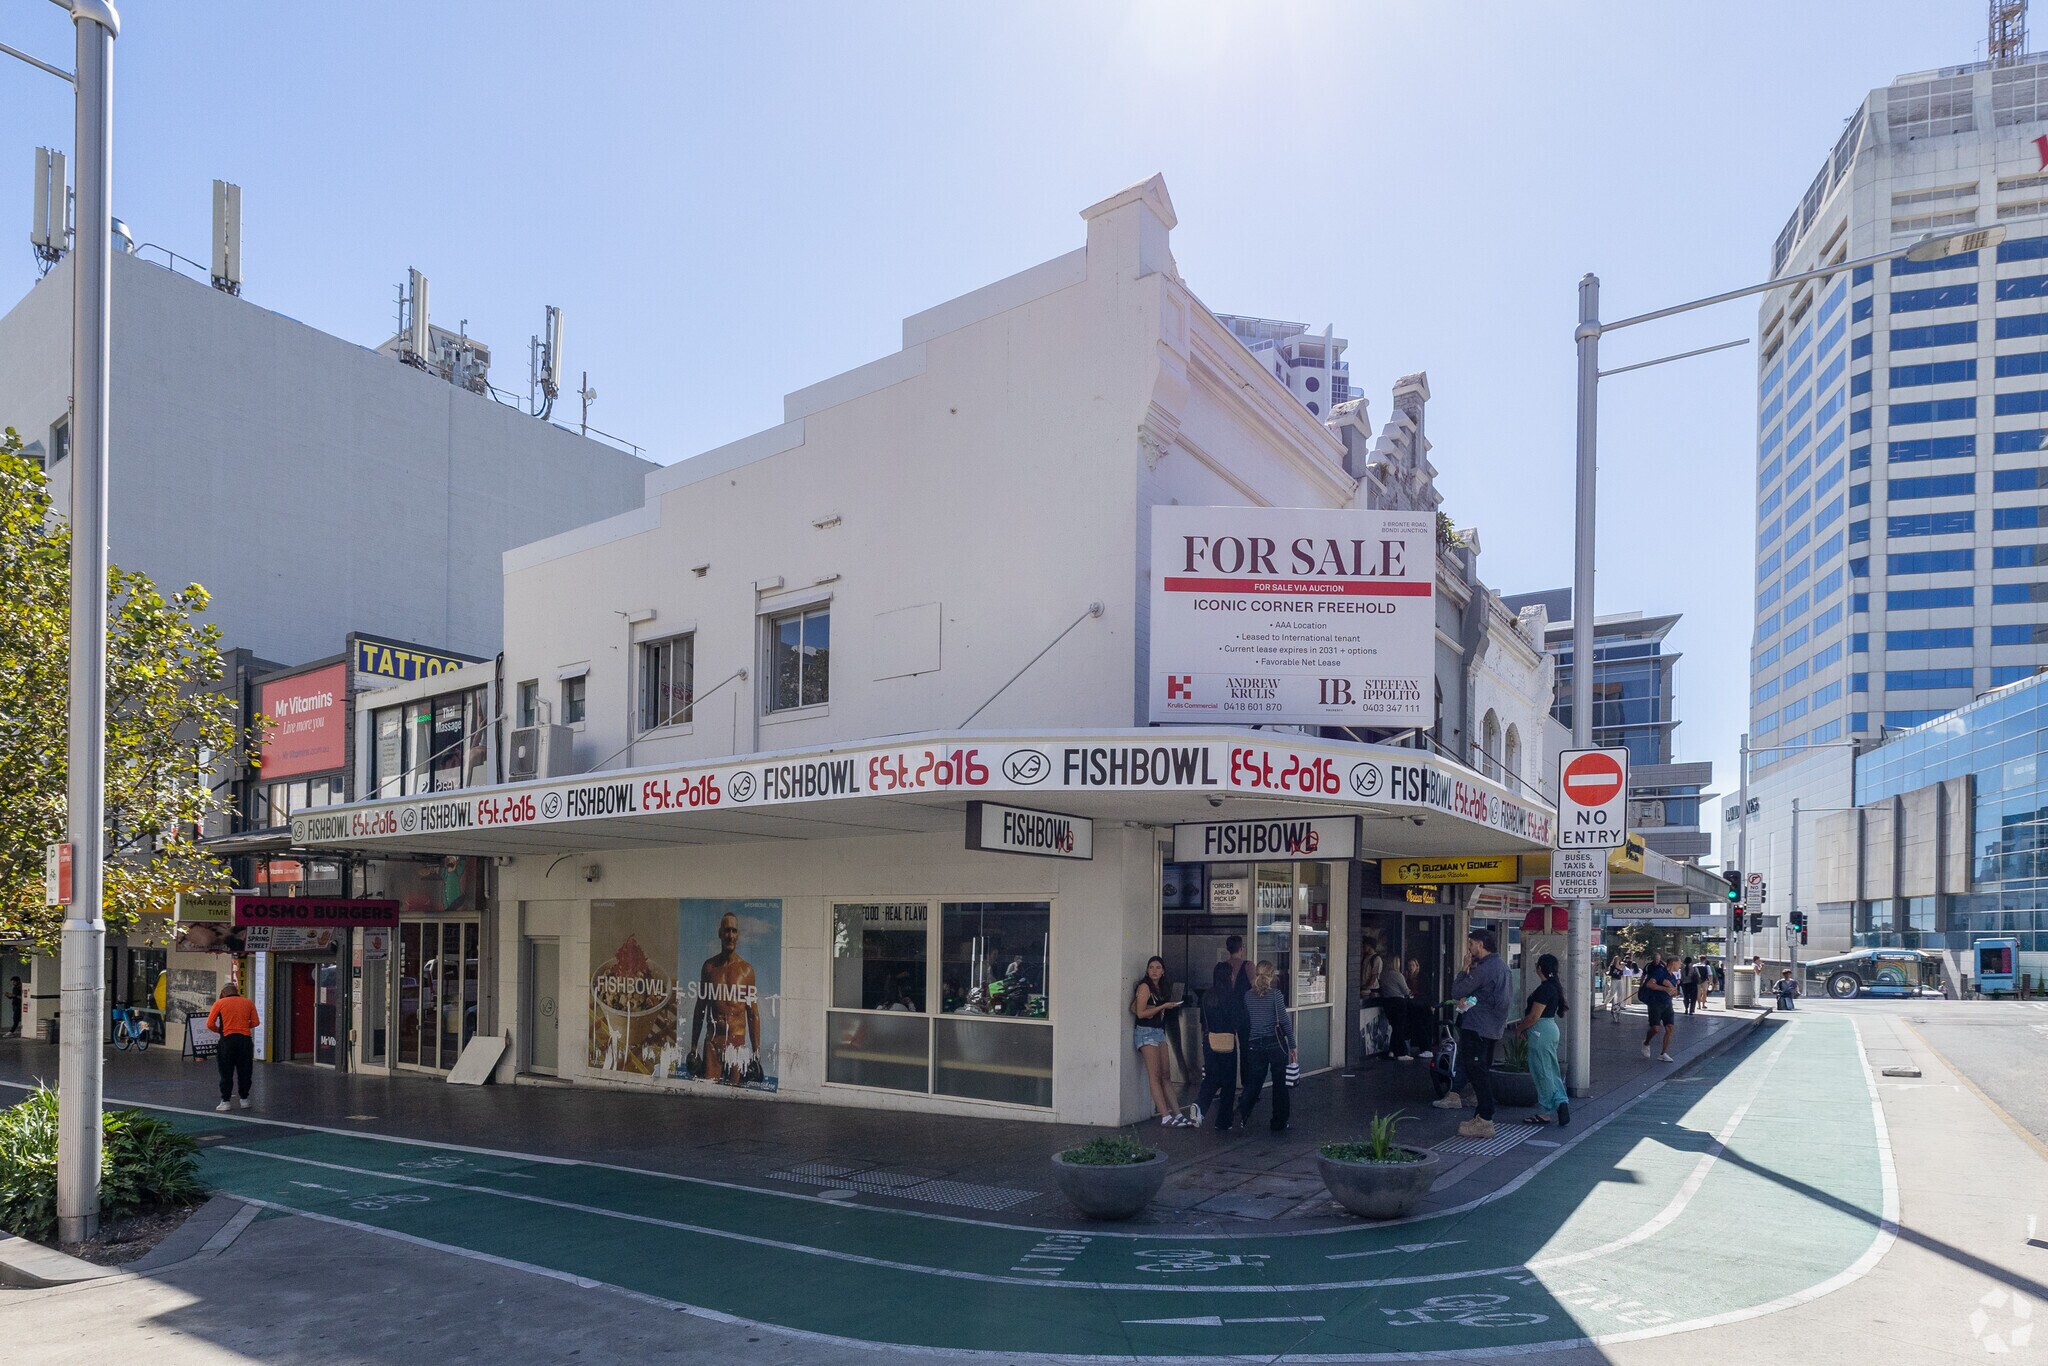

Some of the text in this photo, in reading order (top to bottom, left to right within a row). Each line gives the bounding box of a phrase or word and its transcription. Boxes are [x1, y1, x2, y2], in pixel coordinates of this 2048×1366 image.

[1182, 535, 1406, 577] FOR SALE
[1254, 583, 1344, 592] FOR SALE VIA AUCTION
[1193, 599, 1396, 614] ICONIC CORNER FREEHOLD
[1275, 621, 1327, 629] AAA Location
[1242, 633, 1270, 641] Leased
[1282, 634, 1333, 642] International
[1224, 645, 1254, 653] Current
[1279, 646, 1308, 656] expires
[1309, 646, 1318, 654] in
[1319, 646, 1338, 654] 2031
[1347, 647, 1378, 656] options
[1261, 658, 1300, 666] Favorable
[1301, 658, 1316, 666] Net
[1226, 678, 1281, 689] ANDREW
[1365, 680, 1418, 690] STEFFAN
[1231, 688, 1276, 699] KRULIS
[1318, 679, 1356, 705] IB.
[1363, 690, 1420, 700] IPPOLITO
[276, 691, 333, 718] Mr Vitamins
[1224, 702, 1282, 712] 0418 601 870
[1363, 704, 1384, 712] 0403
[1386, 704, 1402, 712] 347
[442, 706, 456, 719] Thai
[282, 716, 324, 735] Live more you
[436, 720, 462, 734] Massage
[308, 815, 349, 842] FISHBOWL
[421, 801, 474, 831] FISHBOWL
[567, 784, 636, 818] FISHBOWL
[764, 759, 860, 800] FISHBOWL
[1064, 747, 1217, 786] FISHBOWL
[1391, 765, 1452, 811] FISHBOWL
[1576, 810, 1608, 826] NO
[1004, 811, 1073, 852] FISHBOWL
[1563, 830, 1621, 844] ENTRY
[1204, 822, 1319, 855] FISHBOWL
[1565, 854, 1592, 862] BUSES,
[1422, 863, 1458, 872] GUZMAN
[1467, 861, 1498, 870] GOMEZ
[1554, 870, 1602, 878] EMERGENCY
[242, 904, 393, 920] COSMO BURGERS
[885, 906, 902, 920] REAL
[905, 906, 927, 920] FLAVO
[251, 926, 269, 935] 116
[597, 976, 758, 1004] FISHBOWL + SUMMER
